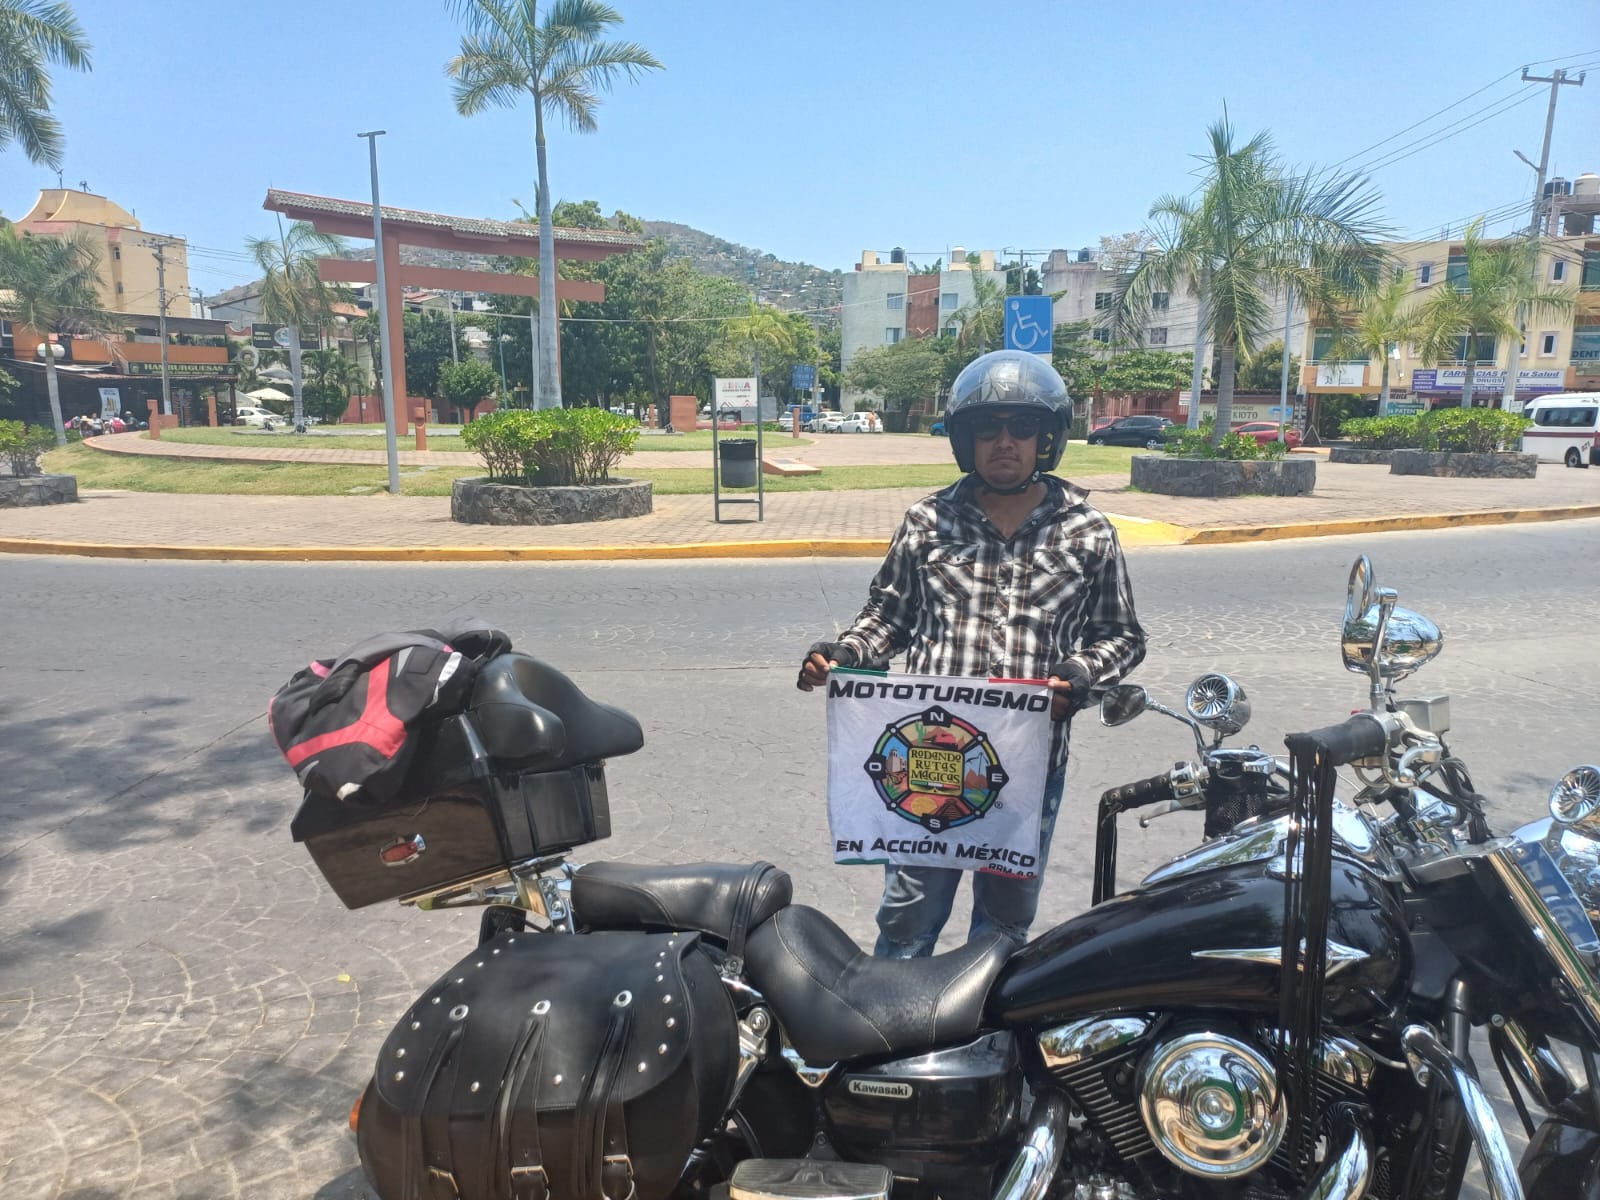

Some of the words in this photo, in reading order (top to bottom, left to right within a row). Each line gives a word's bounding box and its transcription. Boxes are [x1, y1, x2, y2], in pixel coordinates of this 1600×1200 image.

[829, 679, 1050, 713] MOTOTURISMO
[929, 711, 944, 722] N
[991, 773, 1003, 782] E
[929, 818, 941, 828] S
[836, 839, 864, 852] EN
[870, 835, 947, 854] ACCIÓN
[954, 842, 1036, 868] MÉXICO
[853, 1081, 908, 1096] Kawasaki
